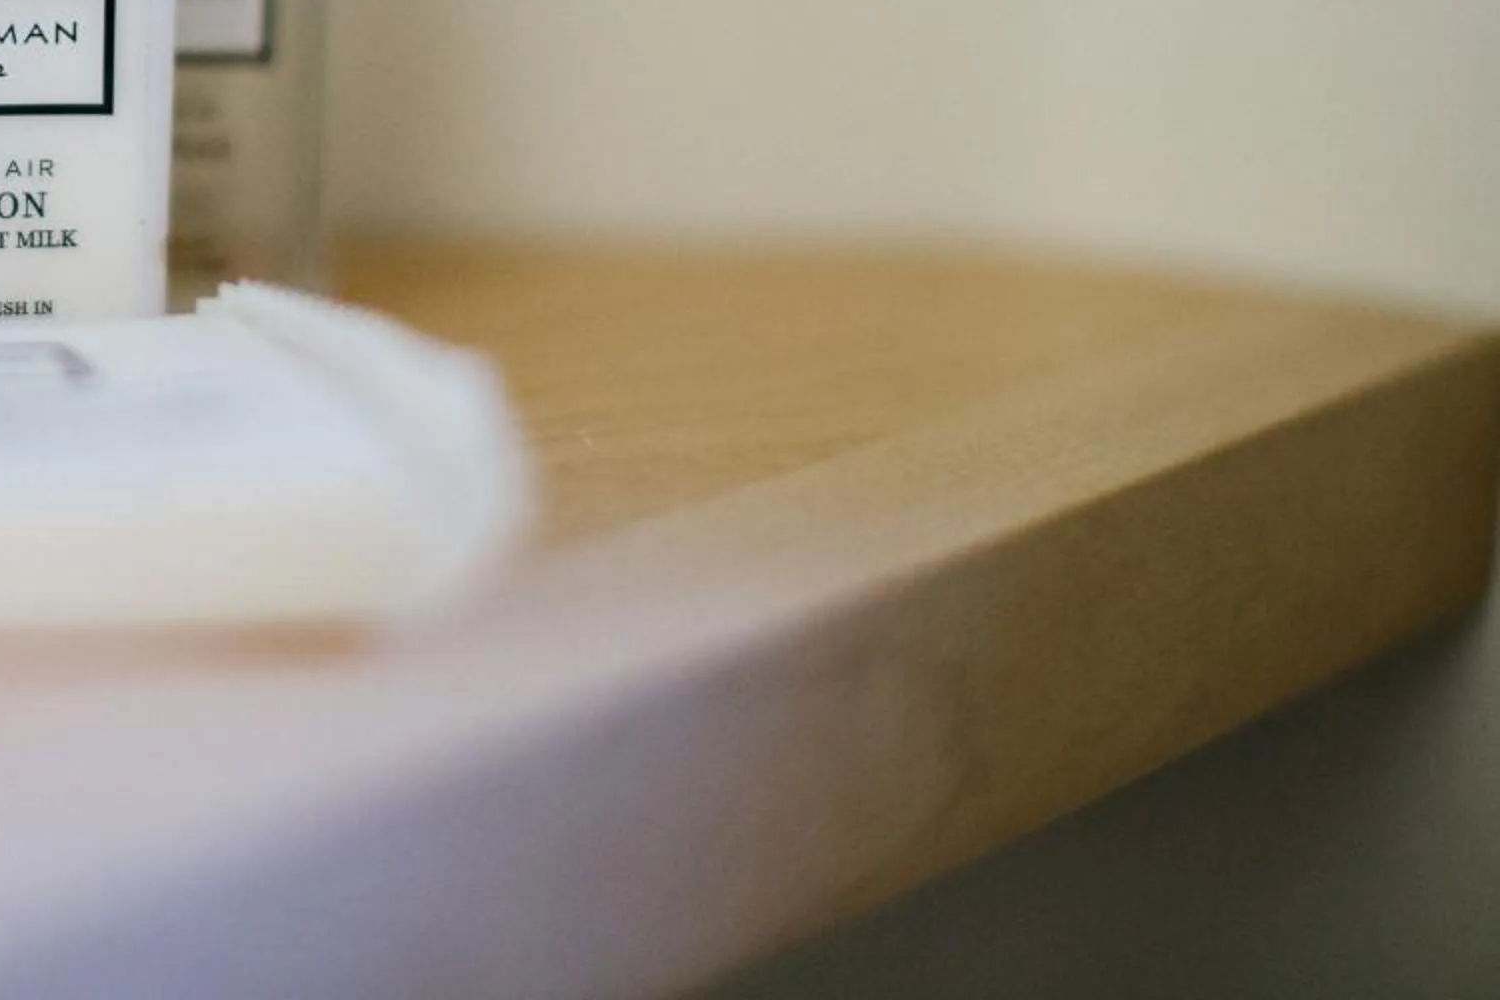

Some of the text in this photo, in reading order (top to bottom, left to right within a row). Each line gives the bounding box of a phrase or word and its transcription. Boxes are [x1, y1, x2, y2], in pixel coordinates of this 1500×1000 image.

[4, 158, 54, 178] AIR
[15, 229, 78, 249] MILK
[32, 299, 54, 317] IN
